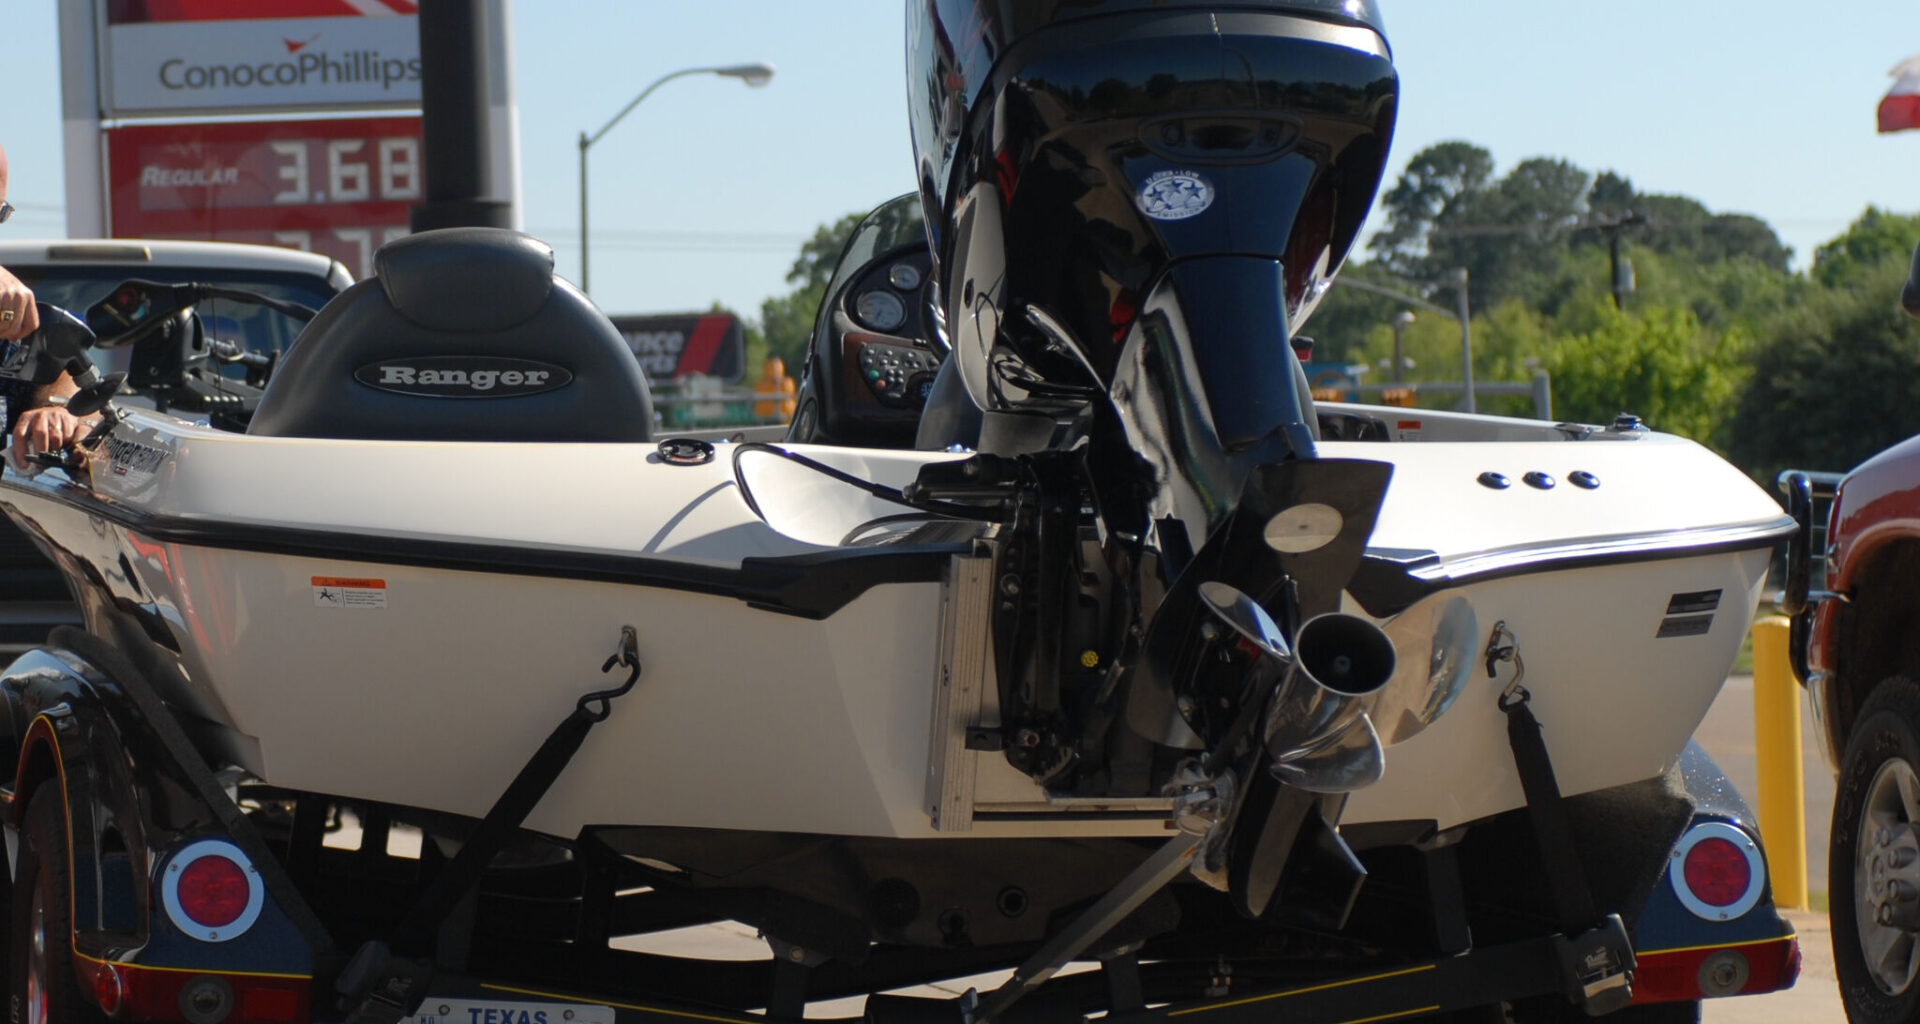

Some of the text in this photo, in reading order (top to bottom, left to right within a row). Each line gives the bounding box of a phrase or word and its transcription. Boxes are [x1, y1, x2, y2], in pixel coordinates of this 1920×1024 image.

[159, 50, 421, 91] ConocoPhillips
[270, 137, 420, 203] 3.68
[379, 366, 550, 391] Ranger
[467, 1008, 548, 1024] TEXAS
